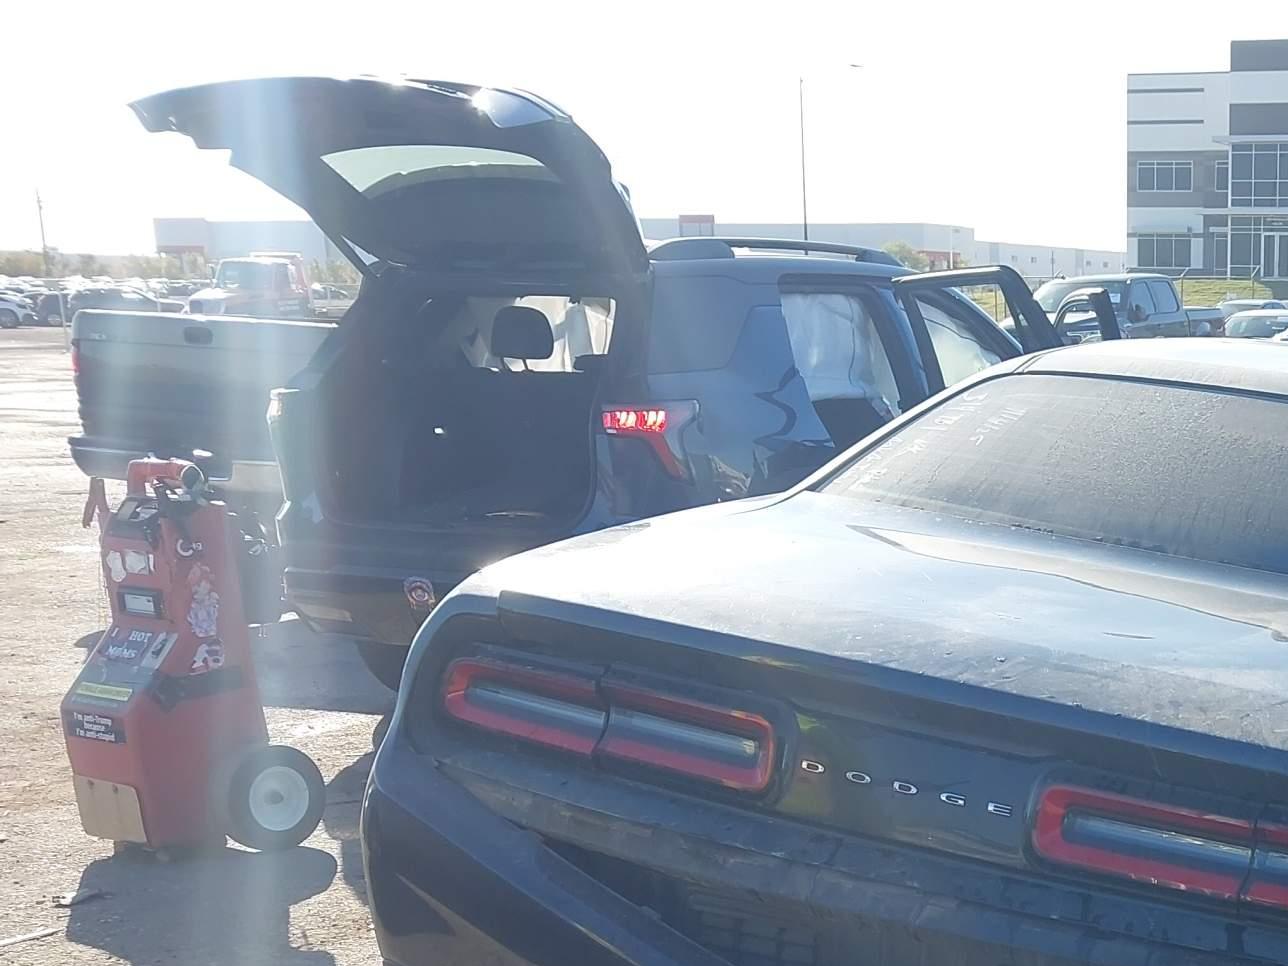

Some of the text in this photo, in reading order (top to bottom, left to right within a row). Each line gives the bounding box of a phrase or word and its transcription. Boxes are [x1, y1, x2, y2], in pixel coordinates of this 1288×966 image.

[111, 627, 152, 642] I HOT
[801, 760, 1012, 816] DODGE
